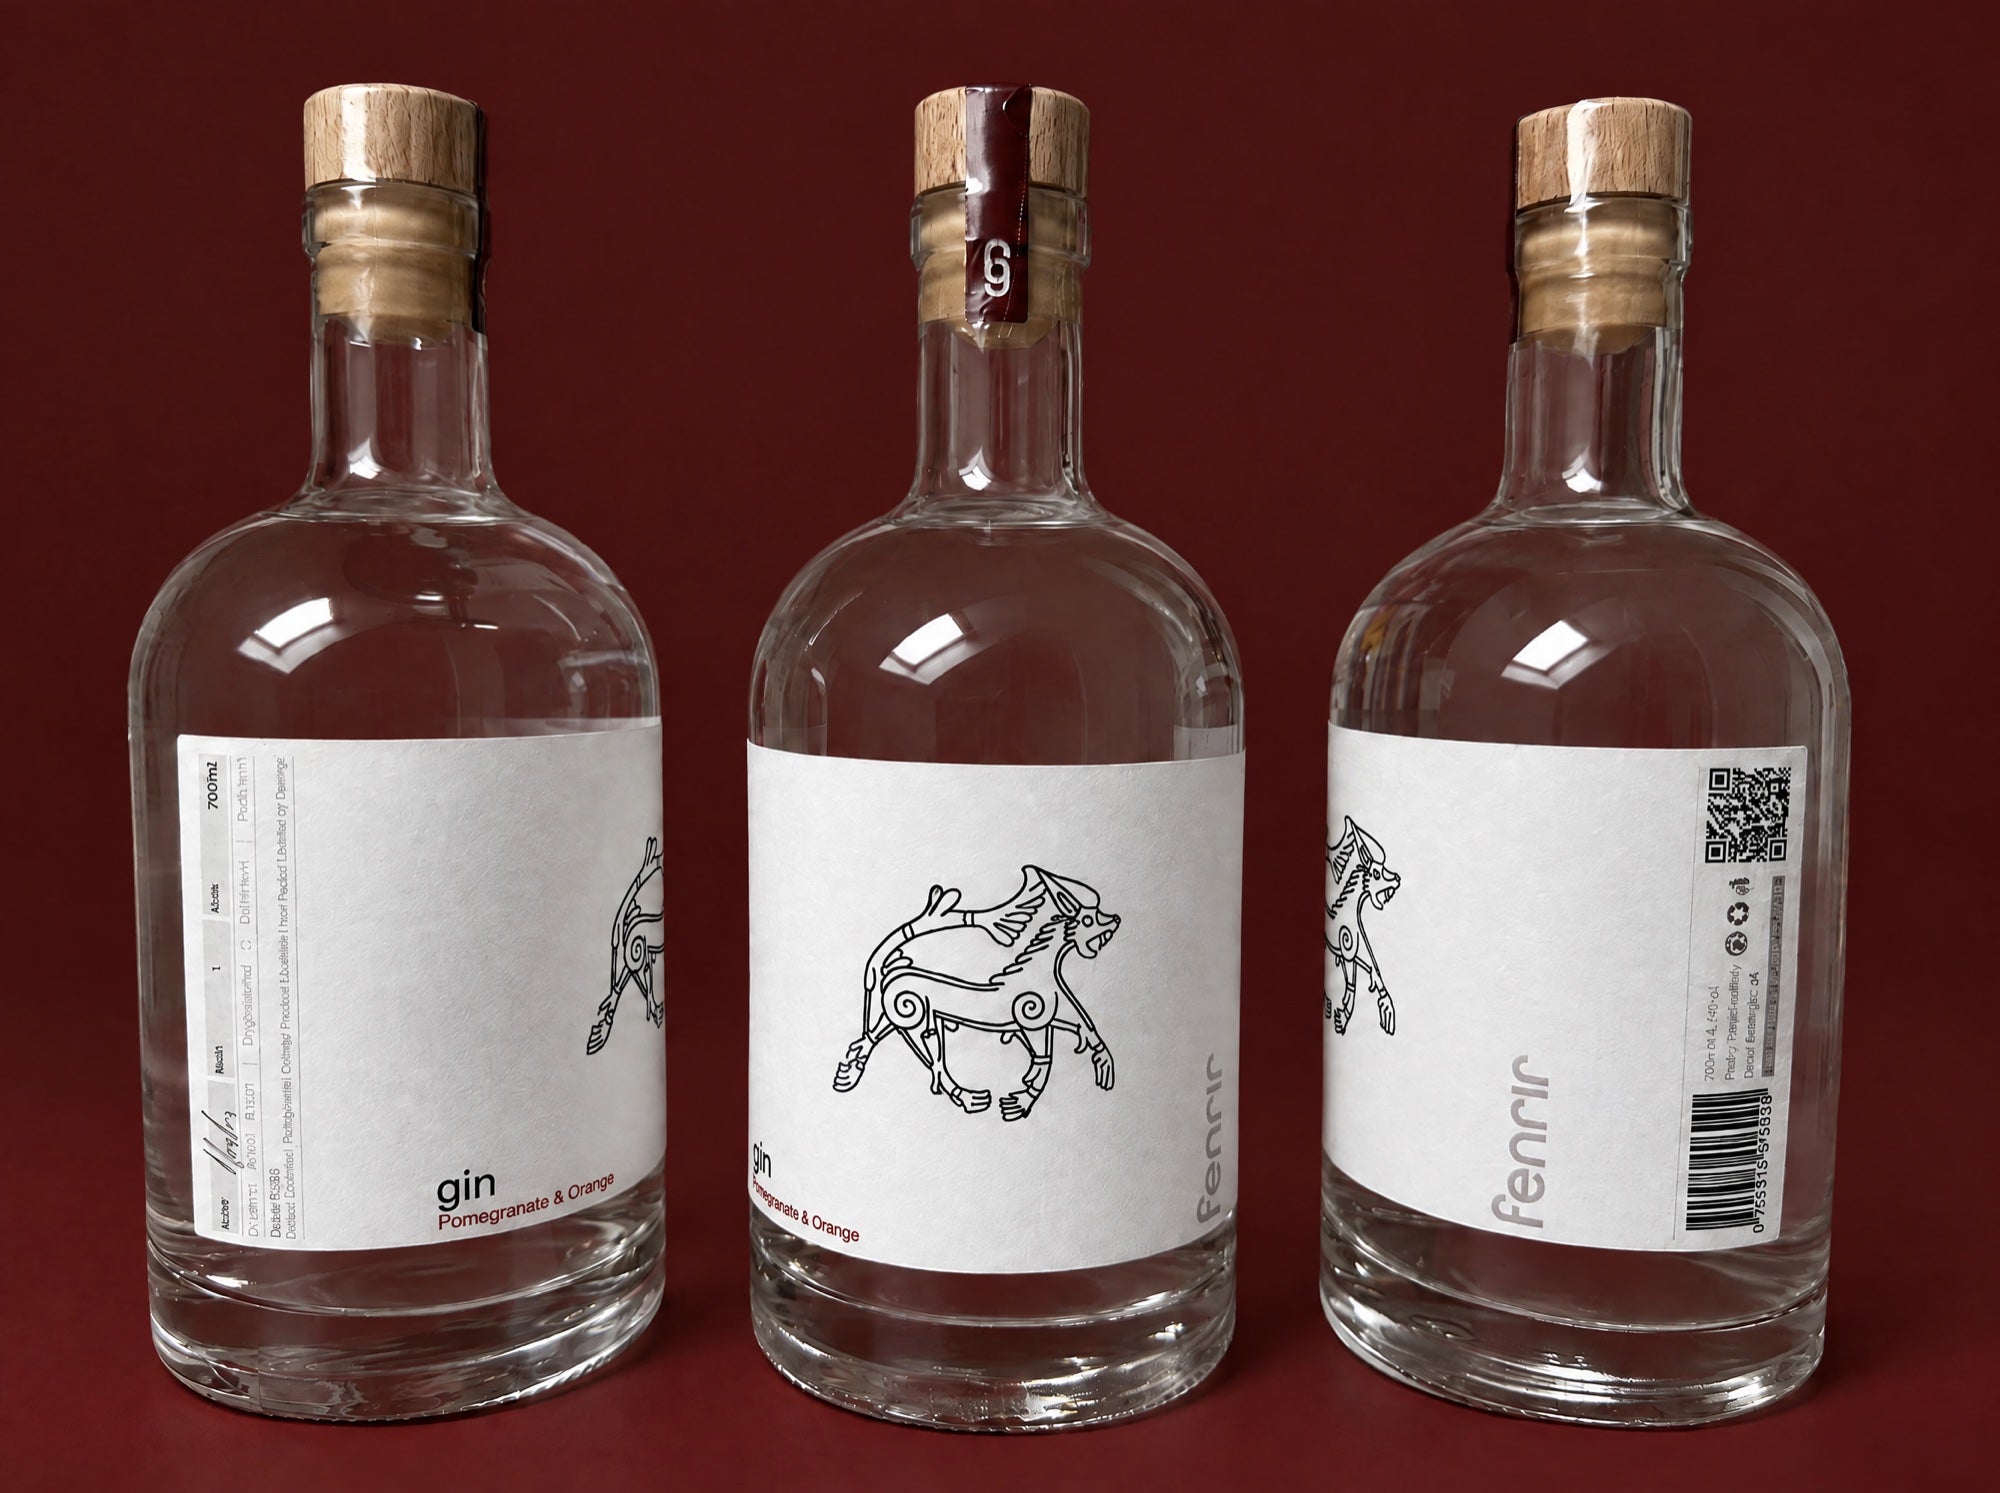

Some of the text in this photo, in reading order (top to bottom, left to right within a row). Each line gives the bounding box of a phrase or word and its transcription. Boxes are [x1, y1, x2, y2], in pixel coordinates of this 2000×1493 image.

[753, 1141, 772, 1178] gin
[437, 1169, 495, 1212] gin
[438, 1173, 614, 1230] Pomegranate & Orange
[752, 1173, 860, 1243] Pomegranate & Orange
